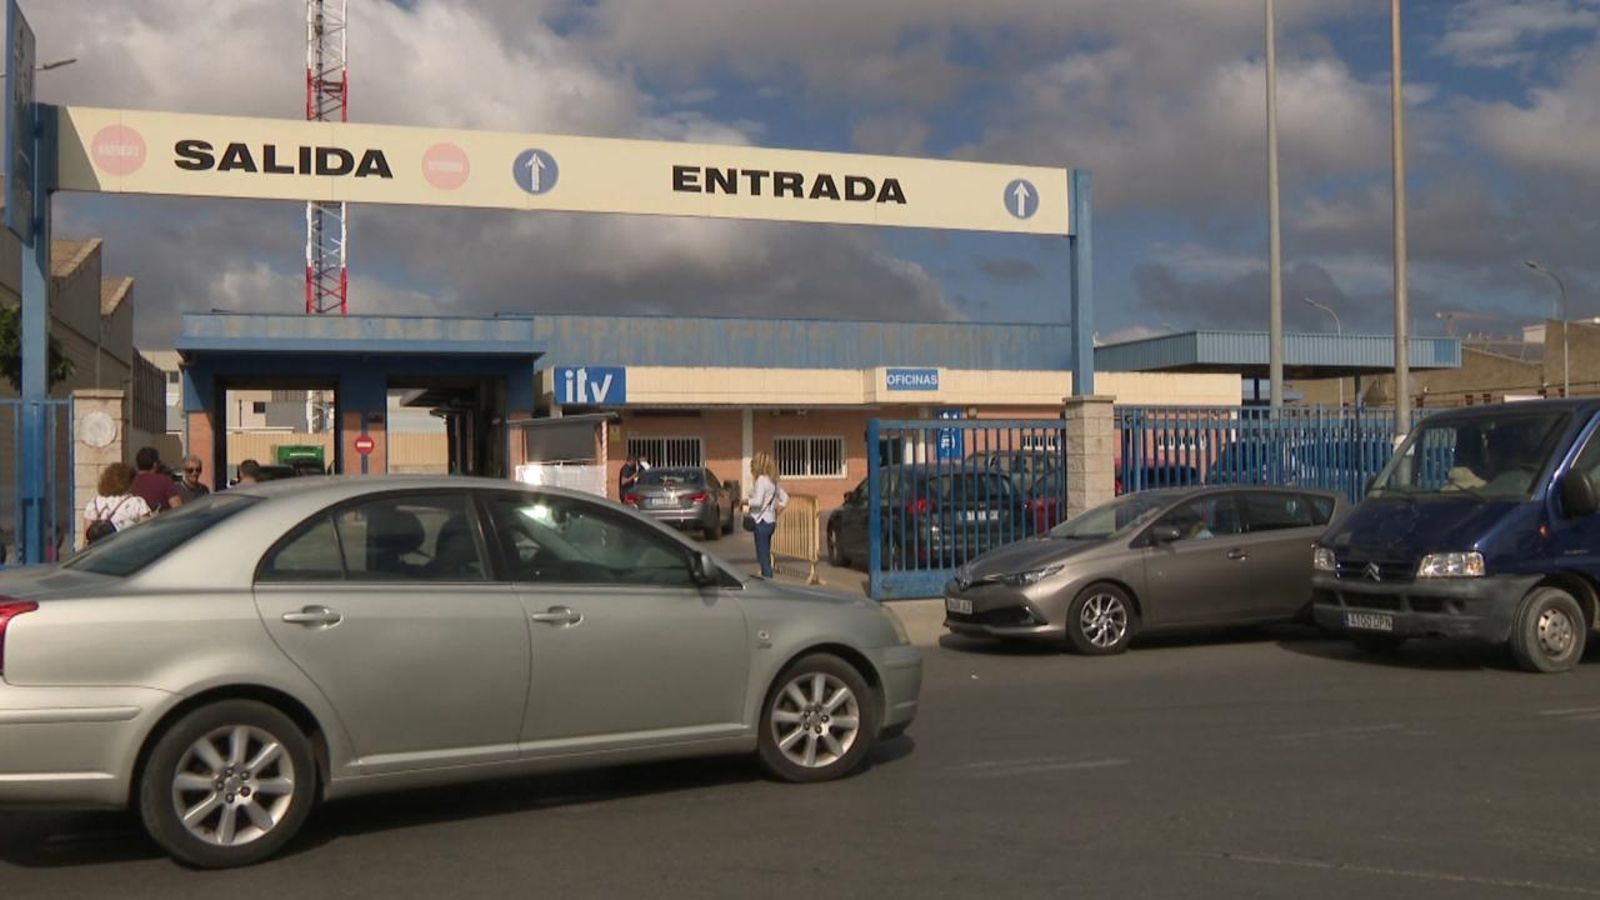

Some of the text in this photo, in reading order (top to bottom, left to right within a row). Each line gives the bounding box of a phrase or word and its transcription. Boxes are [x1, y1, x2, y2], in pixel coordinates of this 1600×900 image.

[174, 139, 393, 179] SALIDA
[672, 165, 907, 205] ENTRADA
[565, 367, 613, 403] itv
[886, 374, 938, 385] OFICINAS
